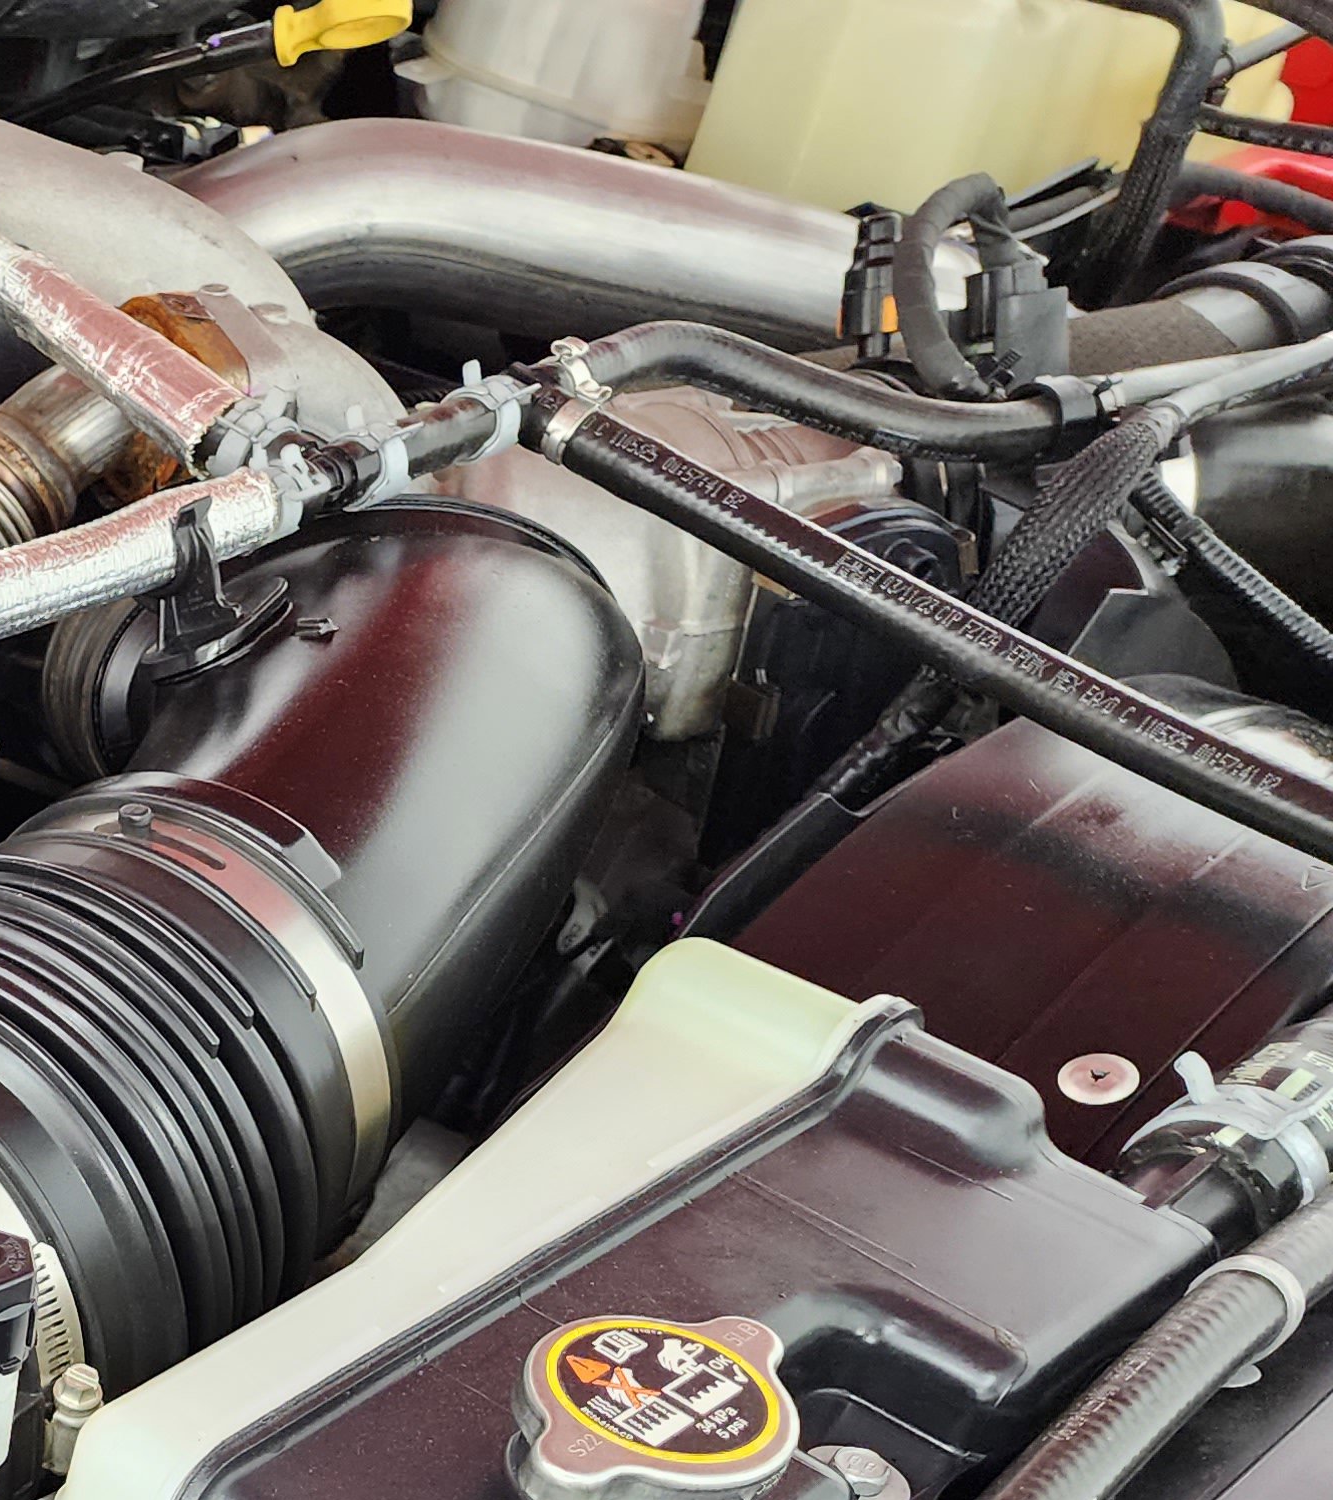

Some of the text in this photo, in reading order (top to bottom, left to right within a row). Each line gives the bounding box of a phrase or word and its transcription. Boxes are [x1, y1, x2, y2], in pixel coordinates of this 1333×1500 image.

[707, 1354, 733, 1372] OK
[695, 1406, 739, 1436] 34 kPa
[715, 1418, 749, 1440] 5 psi
[567, 1432, 603, 1458] S22
